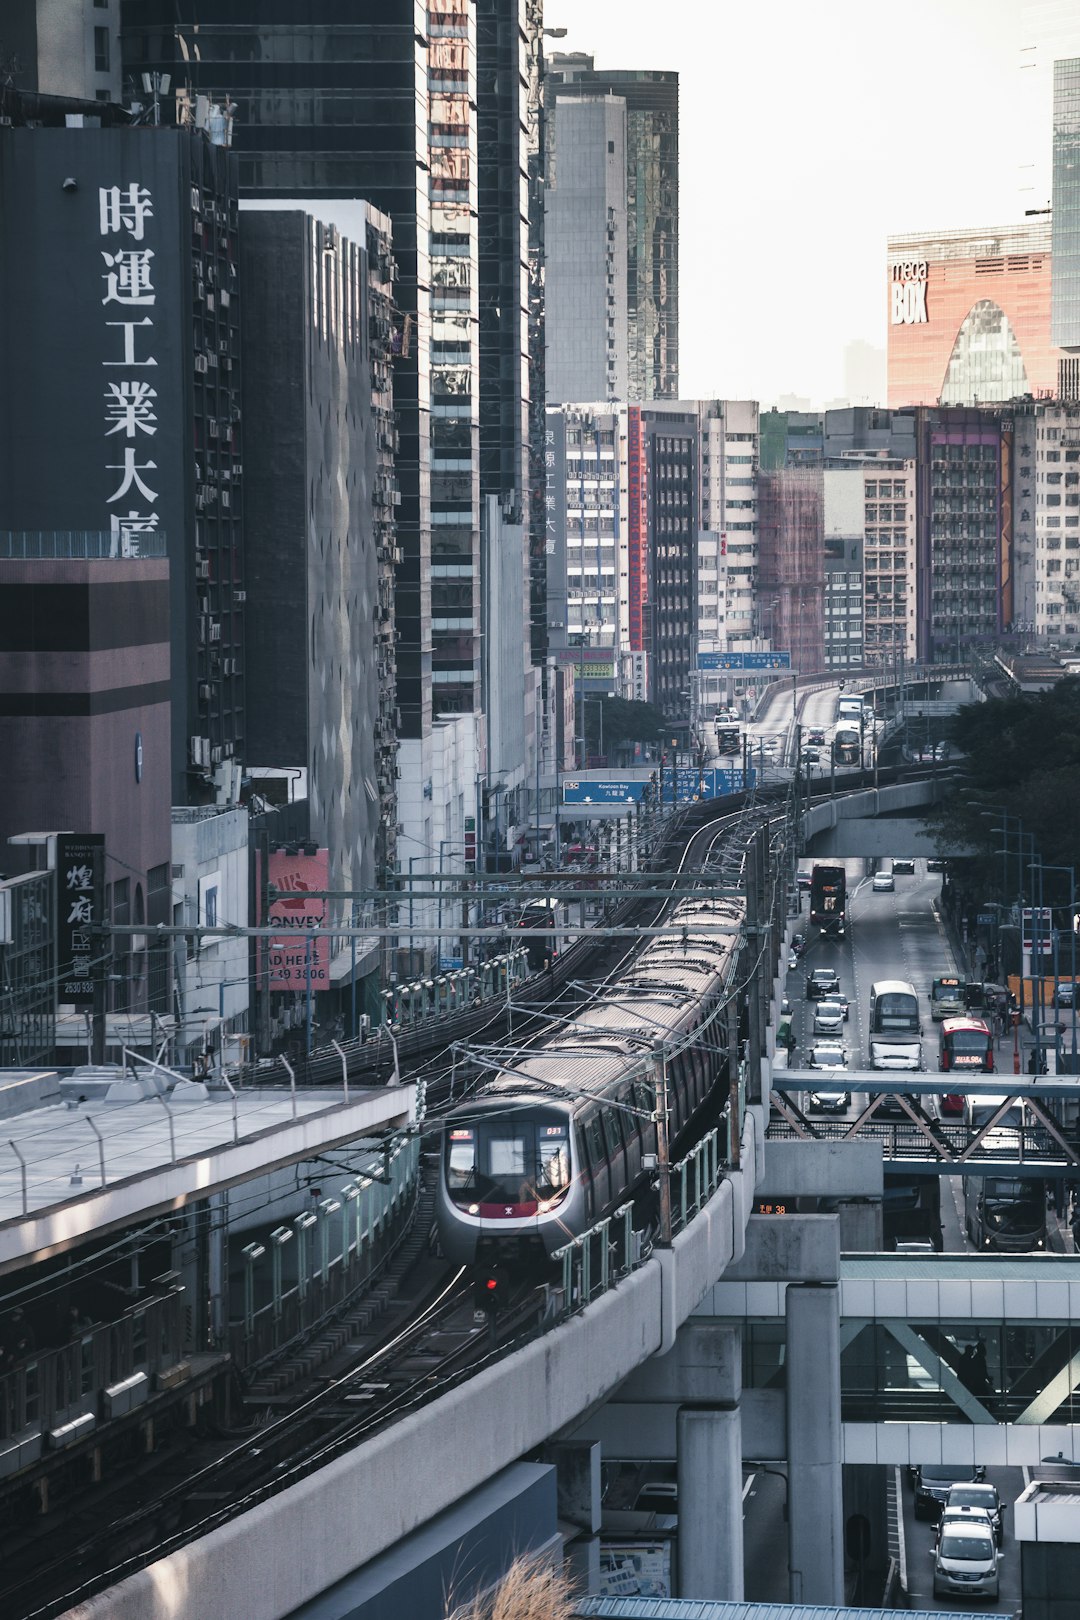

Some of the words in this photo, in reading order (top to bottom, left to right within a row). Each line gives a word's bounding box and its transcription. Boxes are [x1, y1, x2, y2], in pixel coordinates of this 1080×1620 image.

[891, 261, 929, 285] mega
[891, 282, 929, 325] BOX
[270, 916, 324, 928] ONVEY
[546, 1127, 561, 1135] 037
[775, 1205, 786, 1215] 38
